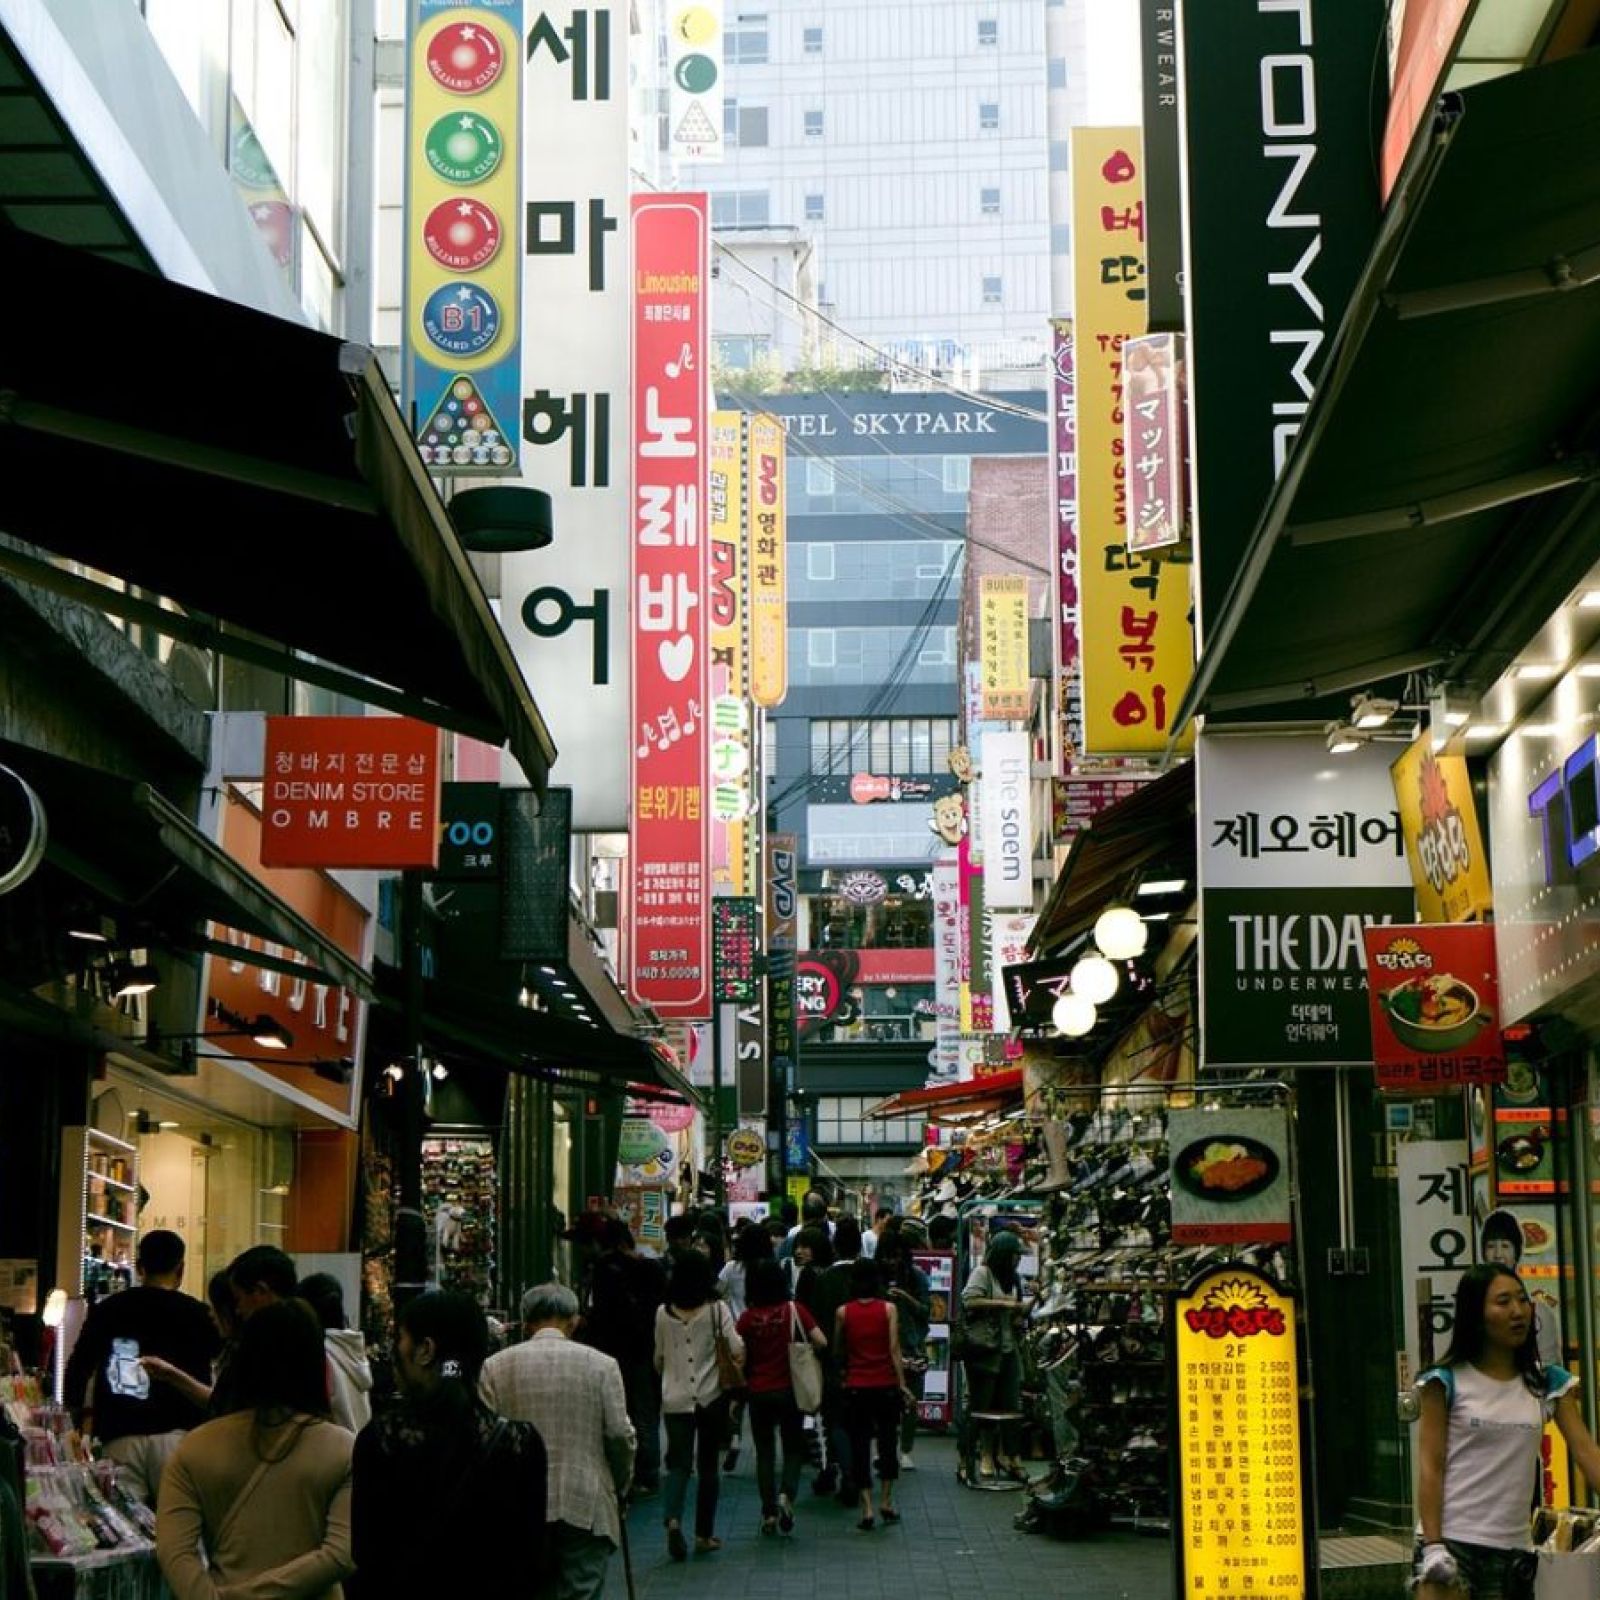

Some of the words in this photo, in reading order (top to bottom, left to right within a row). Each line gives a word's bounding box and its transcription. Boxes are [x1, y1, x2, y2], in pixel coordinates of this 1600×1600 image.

[475, 61, 498, 86] CLUB
[1156, 8, 1176, 108] RWEAR
[474, 151, 496, 176] CLUB
[473, 237, 497, 263] CLUB
[1258, 0, 1325, 480] TONYM
[636, 270, 699, 295] Limousine
[442, 305, 484, 332] B1
[523, 9, 617, 686] 세마헤어
[853, 412, 996, 435] SKYPARK
[760, 454, 778, 506] DVD
[1134, 398, 1166, 528] マッサージ
[757, 513, 778, 587] 영화관
[1103, 545, 1166, 731] 떡볶이
[274, 782, 345, 801] DENIM
[351, 782, 425, 801] STORE
[1001, 757, 1024, 797] the
[272, 809, 423, 830] OMBRE
[1211, 812, 1404, 859] 제오헤어
[463, 854, 493, 867] 크루
[1001, 808, 1022, 882] saem
[771, 850, 794, 920] DVD
[1228, 914, 1302, 972] THE
[1309, 914, 1393, 972] DA
[1292, 1004, 1332, 1022] 더데이
[1224, 1344, 1248, 1359] 2F
